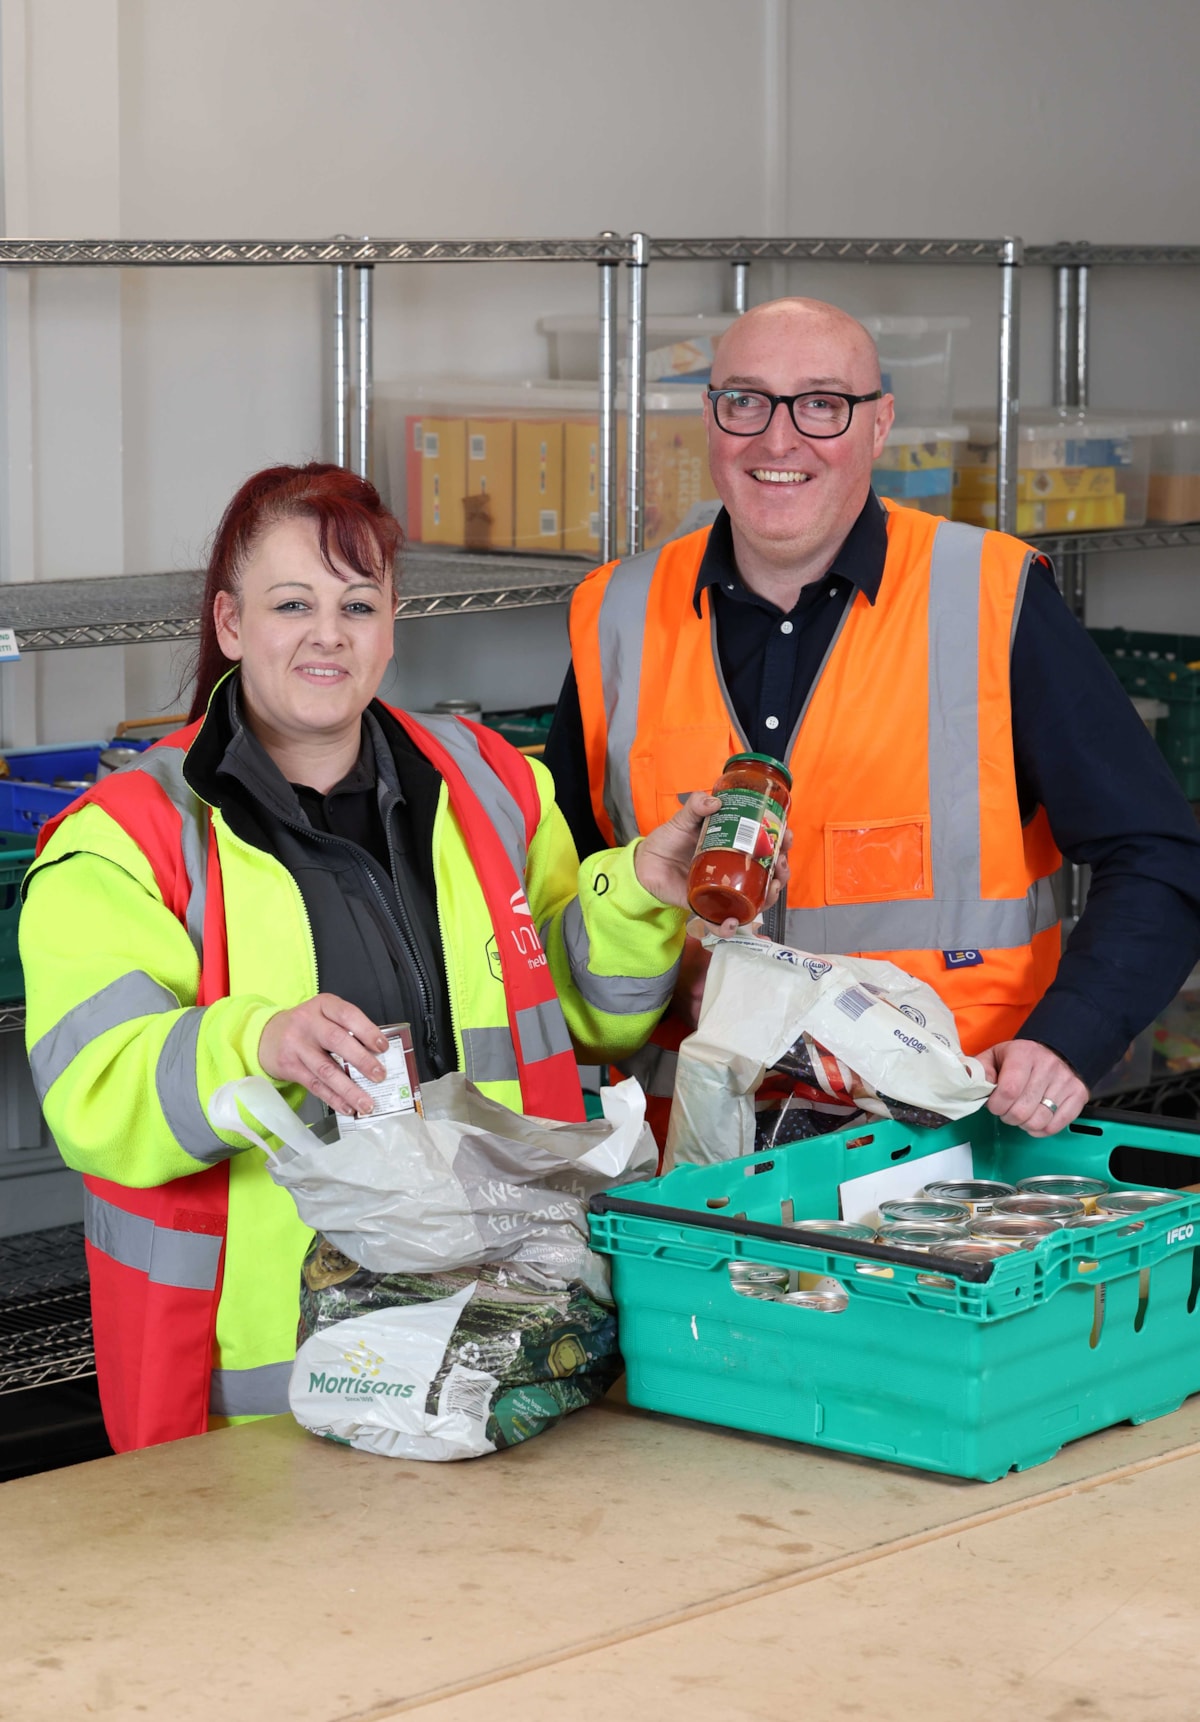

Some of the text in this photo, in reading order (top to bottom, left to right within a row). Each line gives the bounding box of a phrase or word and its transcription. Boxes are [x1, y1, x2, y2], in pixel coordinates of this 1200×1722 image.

[948, 951, 976, 963] LEO
[478, 1180, 522, 1207] We
[1166, 1224, 1194, 1245] IFCO
[309, 1372, 416, 1398] Morrisons
